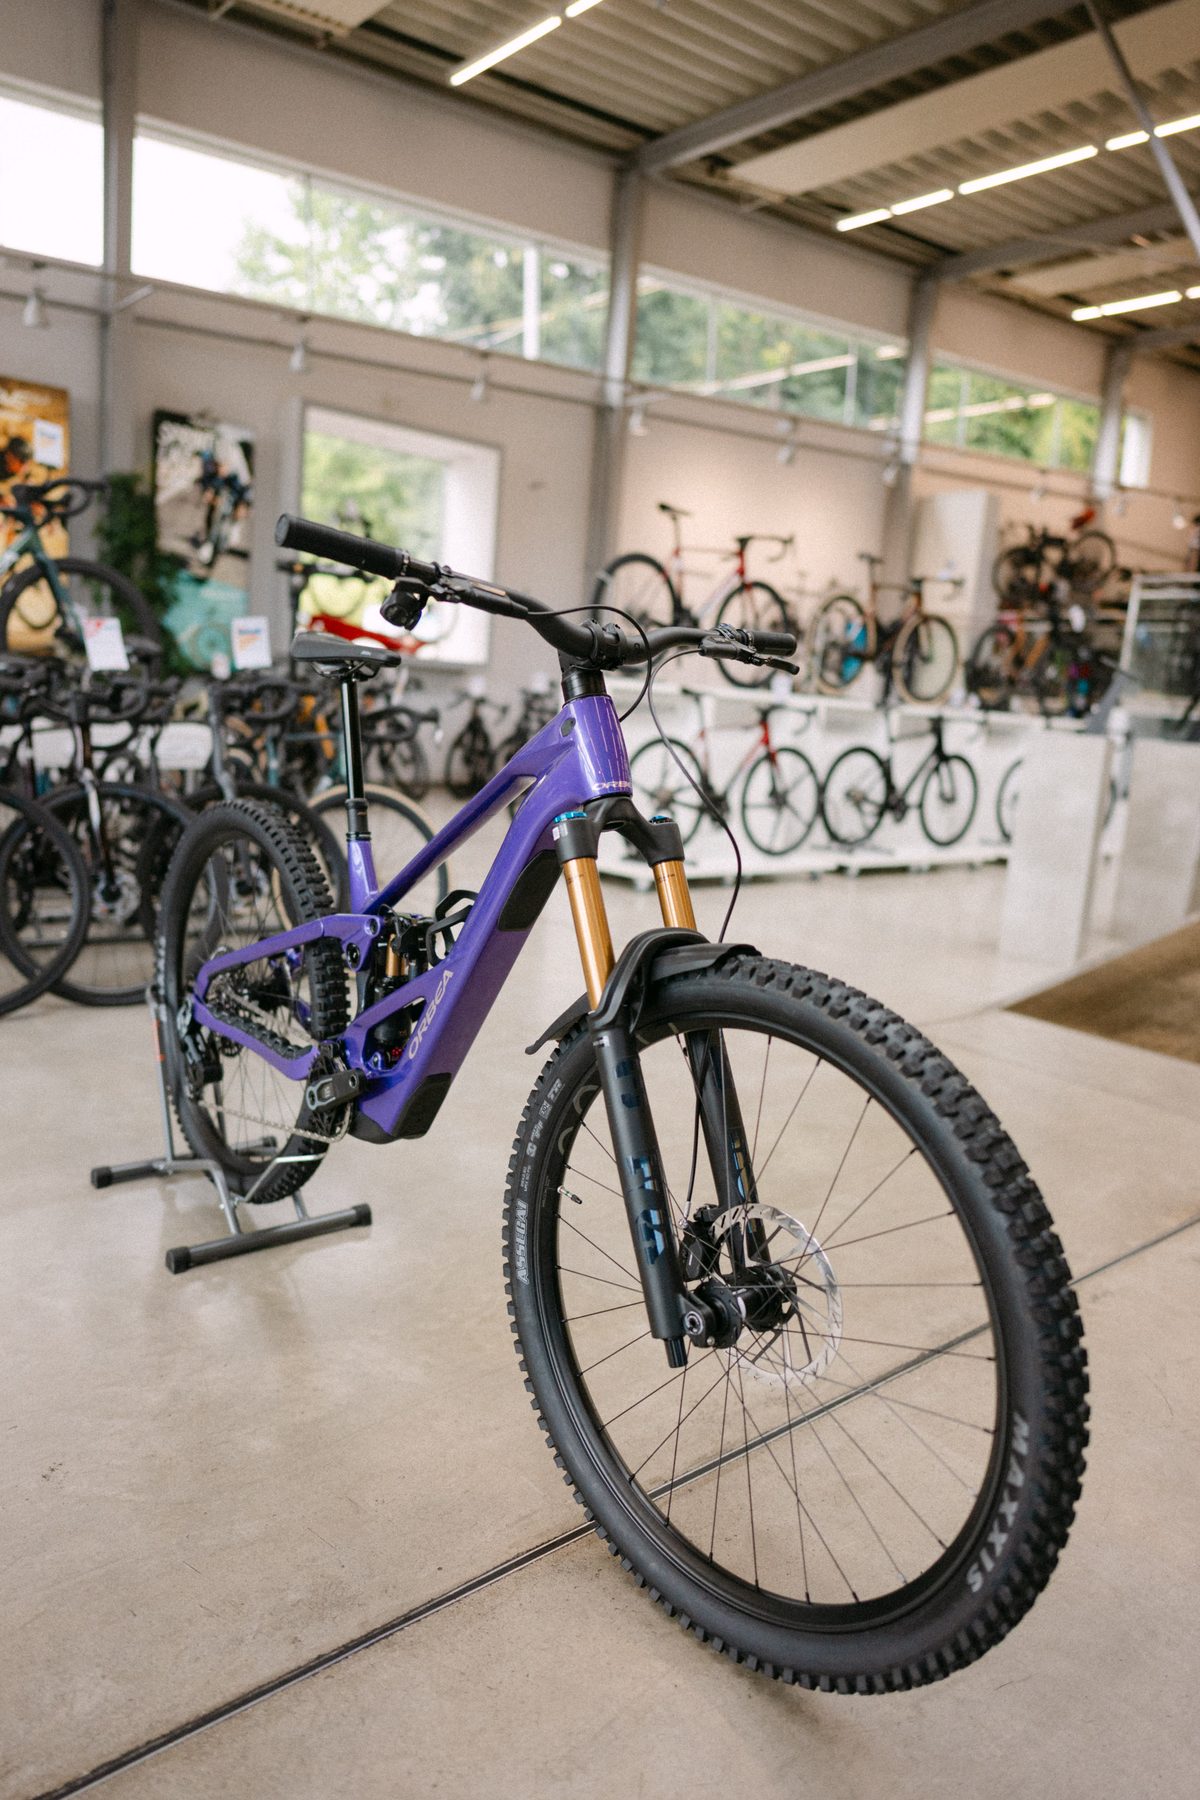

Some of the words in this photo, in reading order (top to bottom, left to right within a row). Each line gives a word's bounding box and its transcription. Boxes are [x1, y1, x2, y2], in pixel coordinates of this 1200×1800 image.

[408, 969, 454, 1060] ORBEA
[515, 1199, 529, 1285] ASSEGAI
[966, 1411, 1030, 1593] MAXXIS
